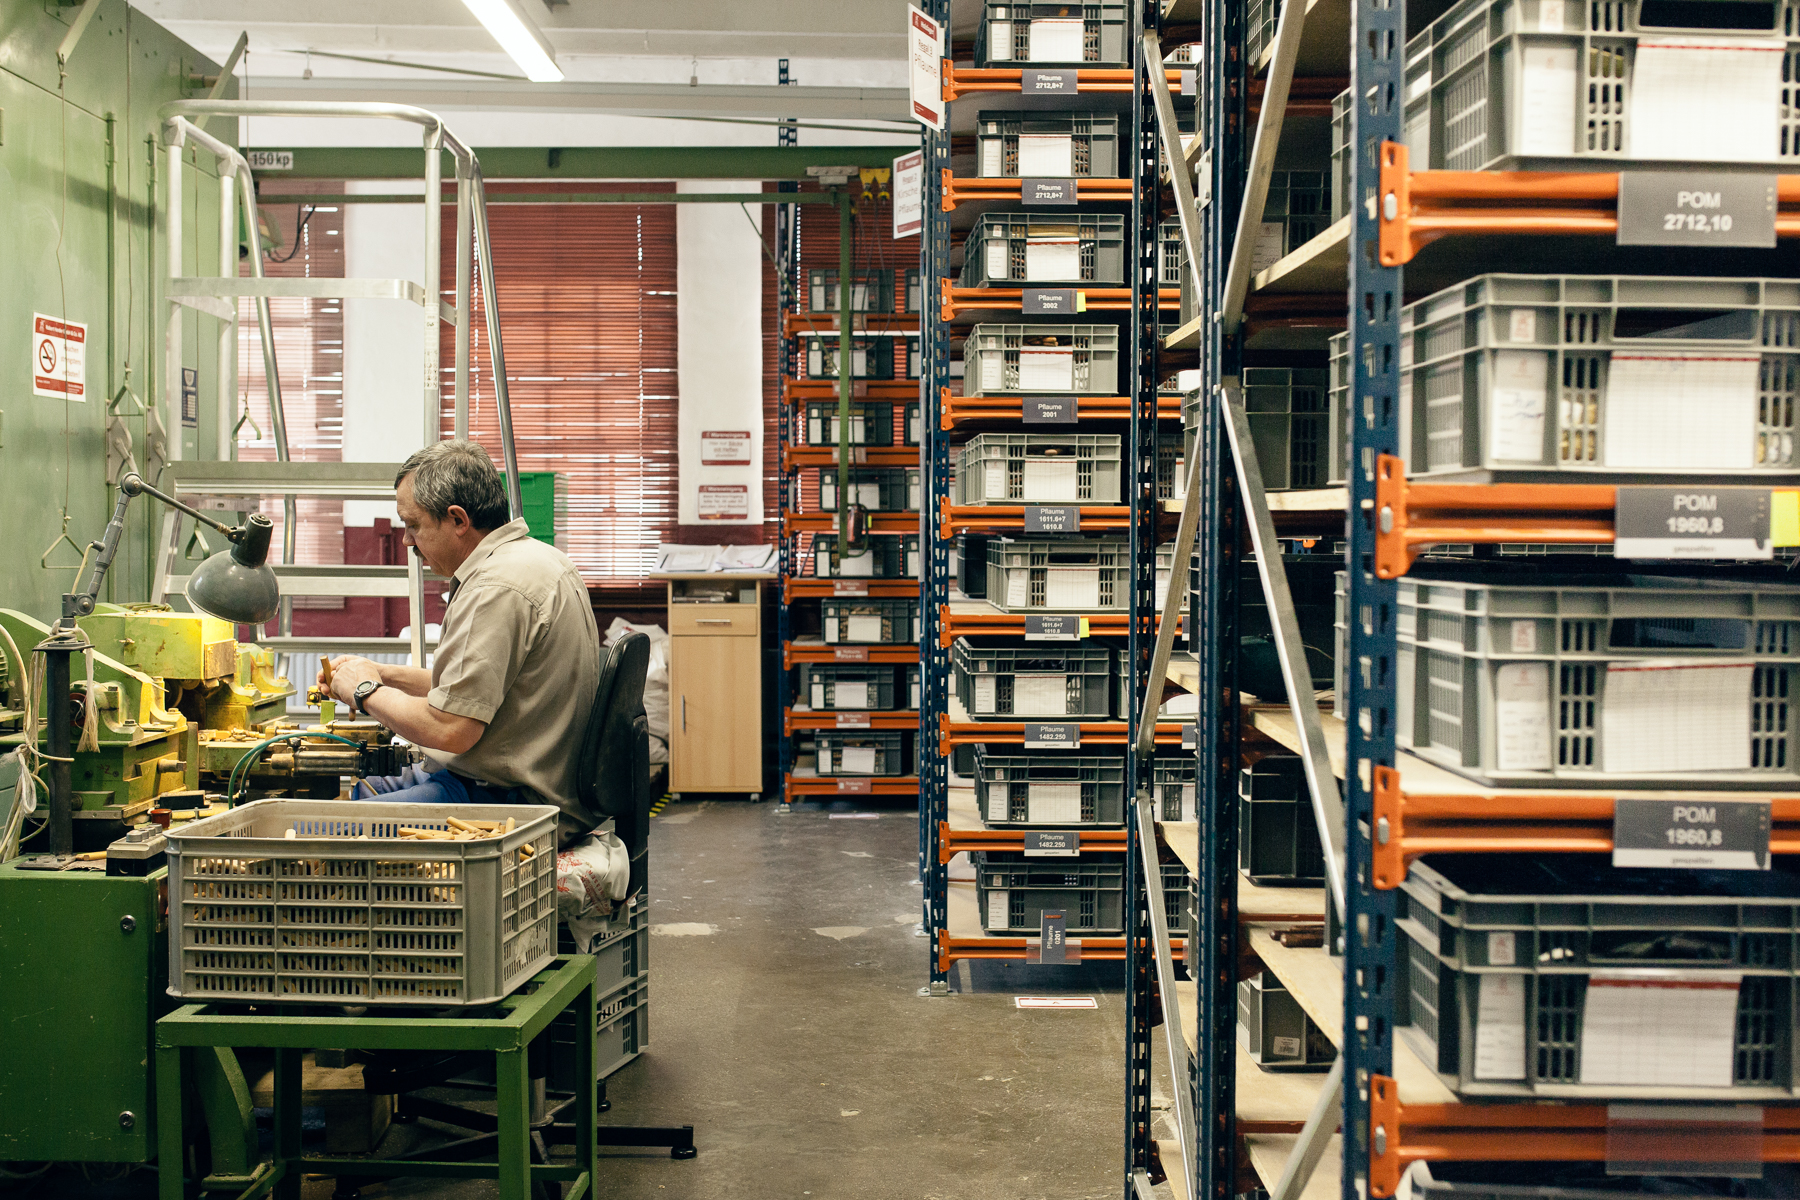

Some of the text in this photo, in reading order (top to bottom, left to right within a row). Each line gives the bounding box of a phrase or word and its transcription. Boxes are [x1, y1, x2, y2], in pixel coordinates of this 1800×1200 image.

[918, 38, 929, 53] Regal
[914, 53, 937, 78] Pflaume
[1677, 191, 1721, 209] POM
[1663, 213, 1733, 233] 2712,10
[1673, 494, 1717, 511] POM
[1666, 516, 1724, 536] 1960,8
[1672, 806, 1716, 823] POM
[1664, 828, 1723, 848] 1960,8
[1046, 925, 1054, 949] Pflaume
